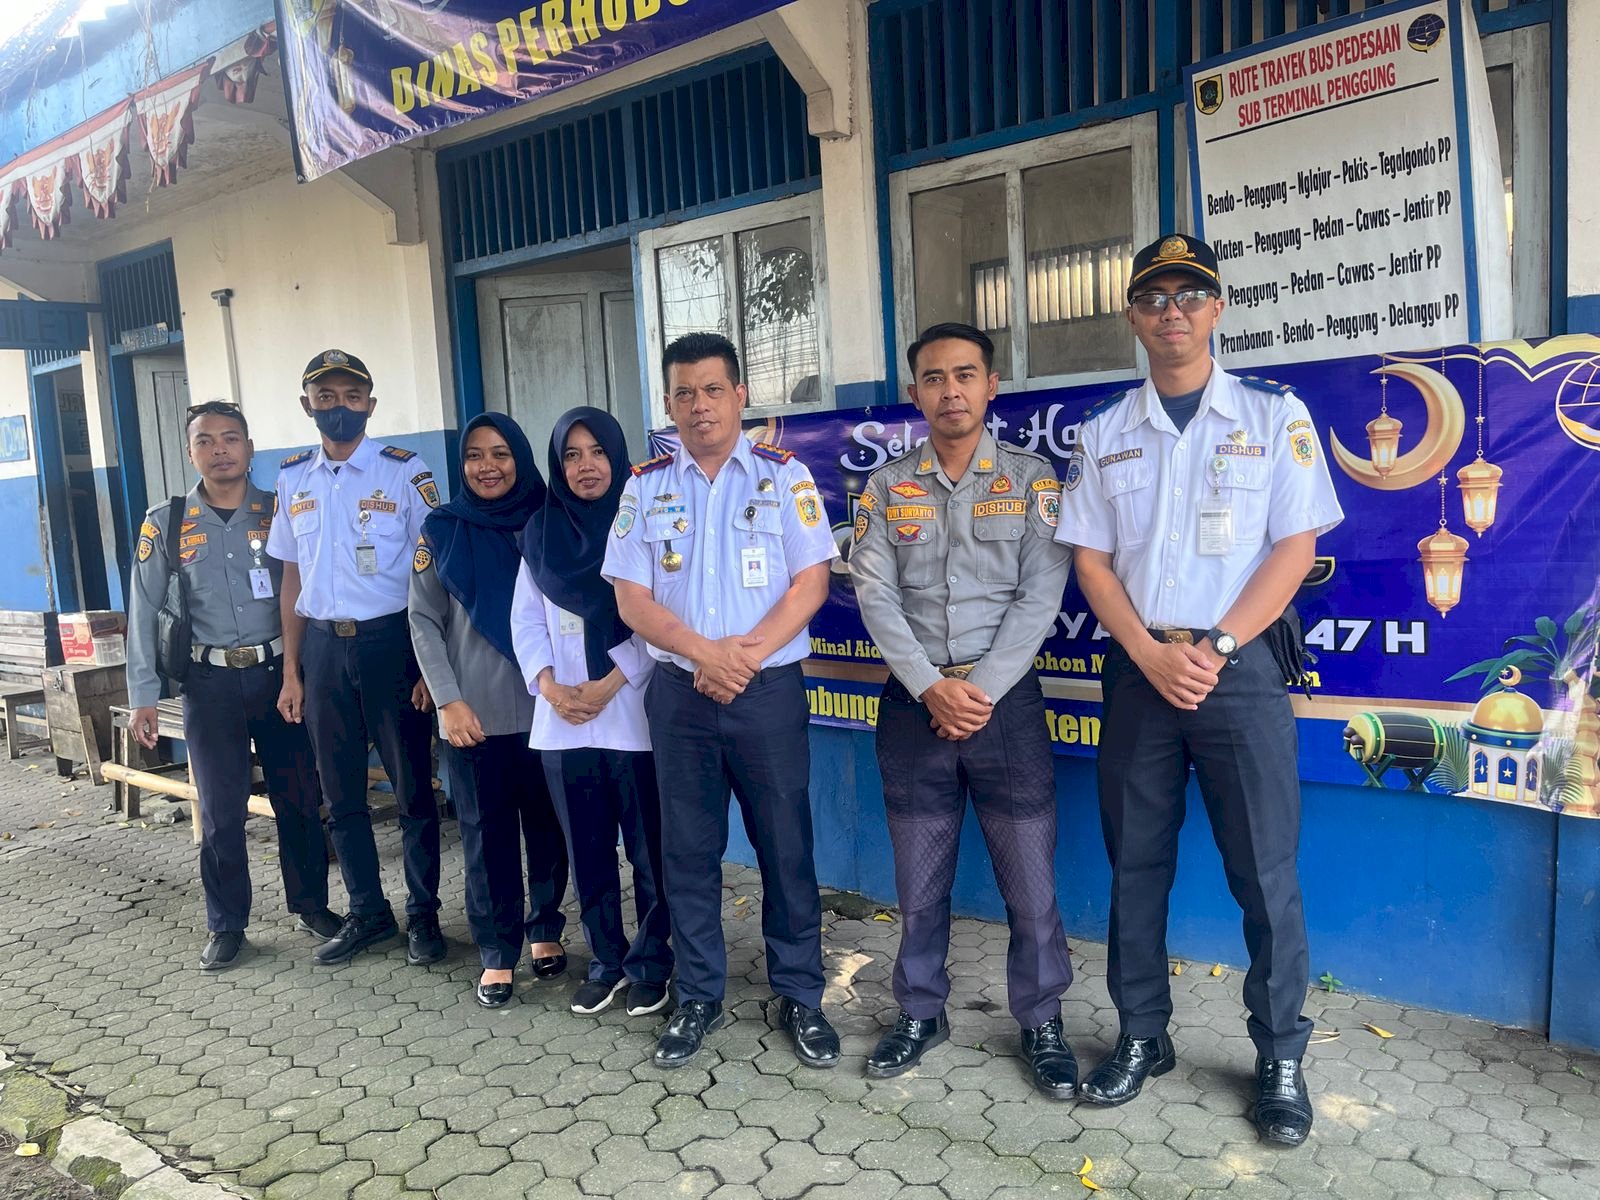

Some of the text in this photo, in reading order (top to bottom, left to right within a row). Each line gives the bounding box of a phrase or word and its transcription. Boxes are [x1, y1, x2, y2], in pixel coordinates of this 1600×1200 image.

[391, 32, 497, 115] DINAS
[1229, 23, 1401, 98] RUTE TRAYEK BUS PEDESAAN
[1238, 62, 1396, 128] SUB TERMINAL PENGGUNG
[1207, 190, 1235, 216] Bendo
[1244, 181, 1287, 209] Penggung
[1297, 167, 1331, 198] Nglajur
[1342, 156, 1368, 184] Pakis
[1379, 141, 1435, 179] Tegalgondo
[1438, 136, 1451, 163] PP
[1213, 237, 1243, 262] Klaten
[1254, 227, 1301, 255] Penggung
[1313, 215, 1344, 241] Pedan
[1355, 208, 1390, 232] Cawas
[1403, 194, 1435, 223] Jentir
[1437, 190, 1451, 215] PP
[1228, 281, 1278, 308] Penggung
[1290, 269, 1324, 295] Pedan
[1337, 261, 1374, 287] Cawas
[1389, 249, 1423, 277] Jentir
[1426, 244, 1441, 270] PP
[1220, 328, 1273, 355] Prambanan
[1282, 318, 1314, 344] Bendo
[1326, 311, 1378, 340] Penggung
[1389, 301, 1441, 328] Delanggu
[1444, 293, 1459, 319] PP
[1100, 449, 1141, 466] GUNAWAN
[1219, 445, 1262, 455] DISHUB
[361, 501, 394, 511] DISHUB
[977, 502, 1023, 515] DISHUB
[809, 637, 852, 657] Minal
[1385, 620, 1425, 653] H
